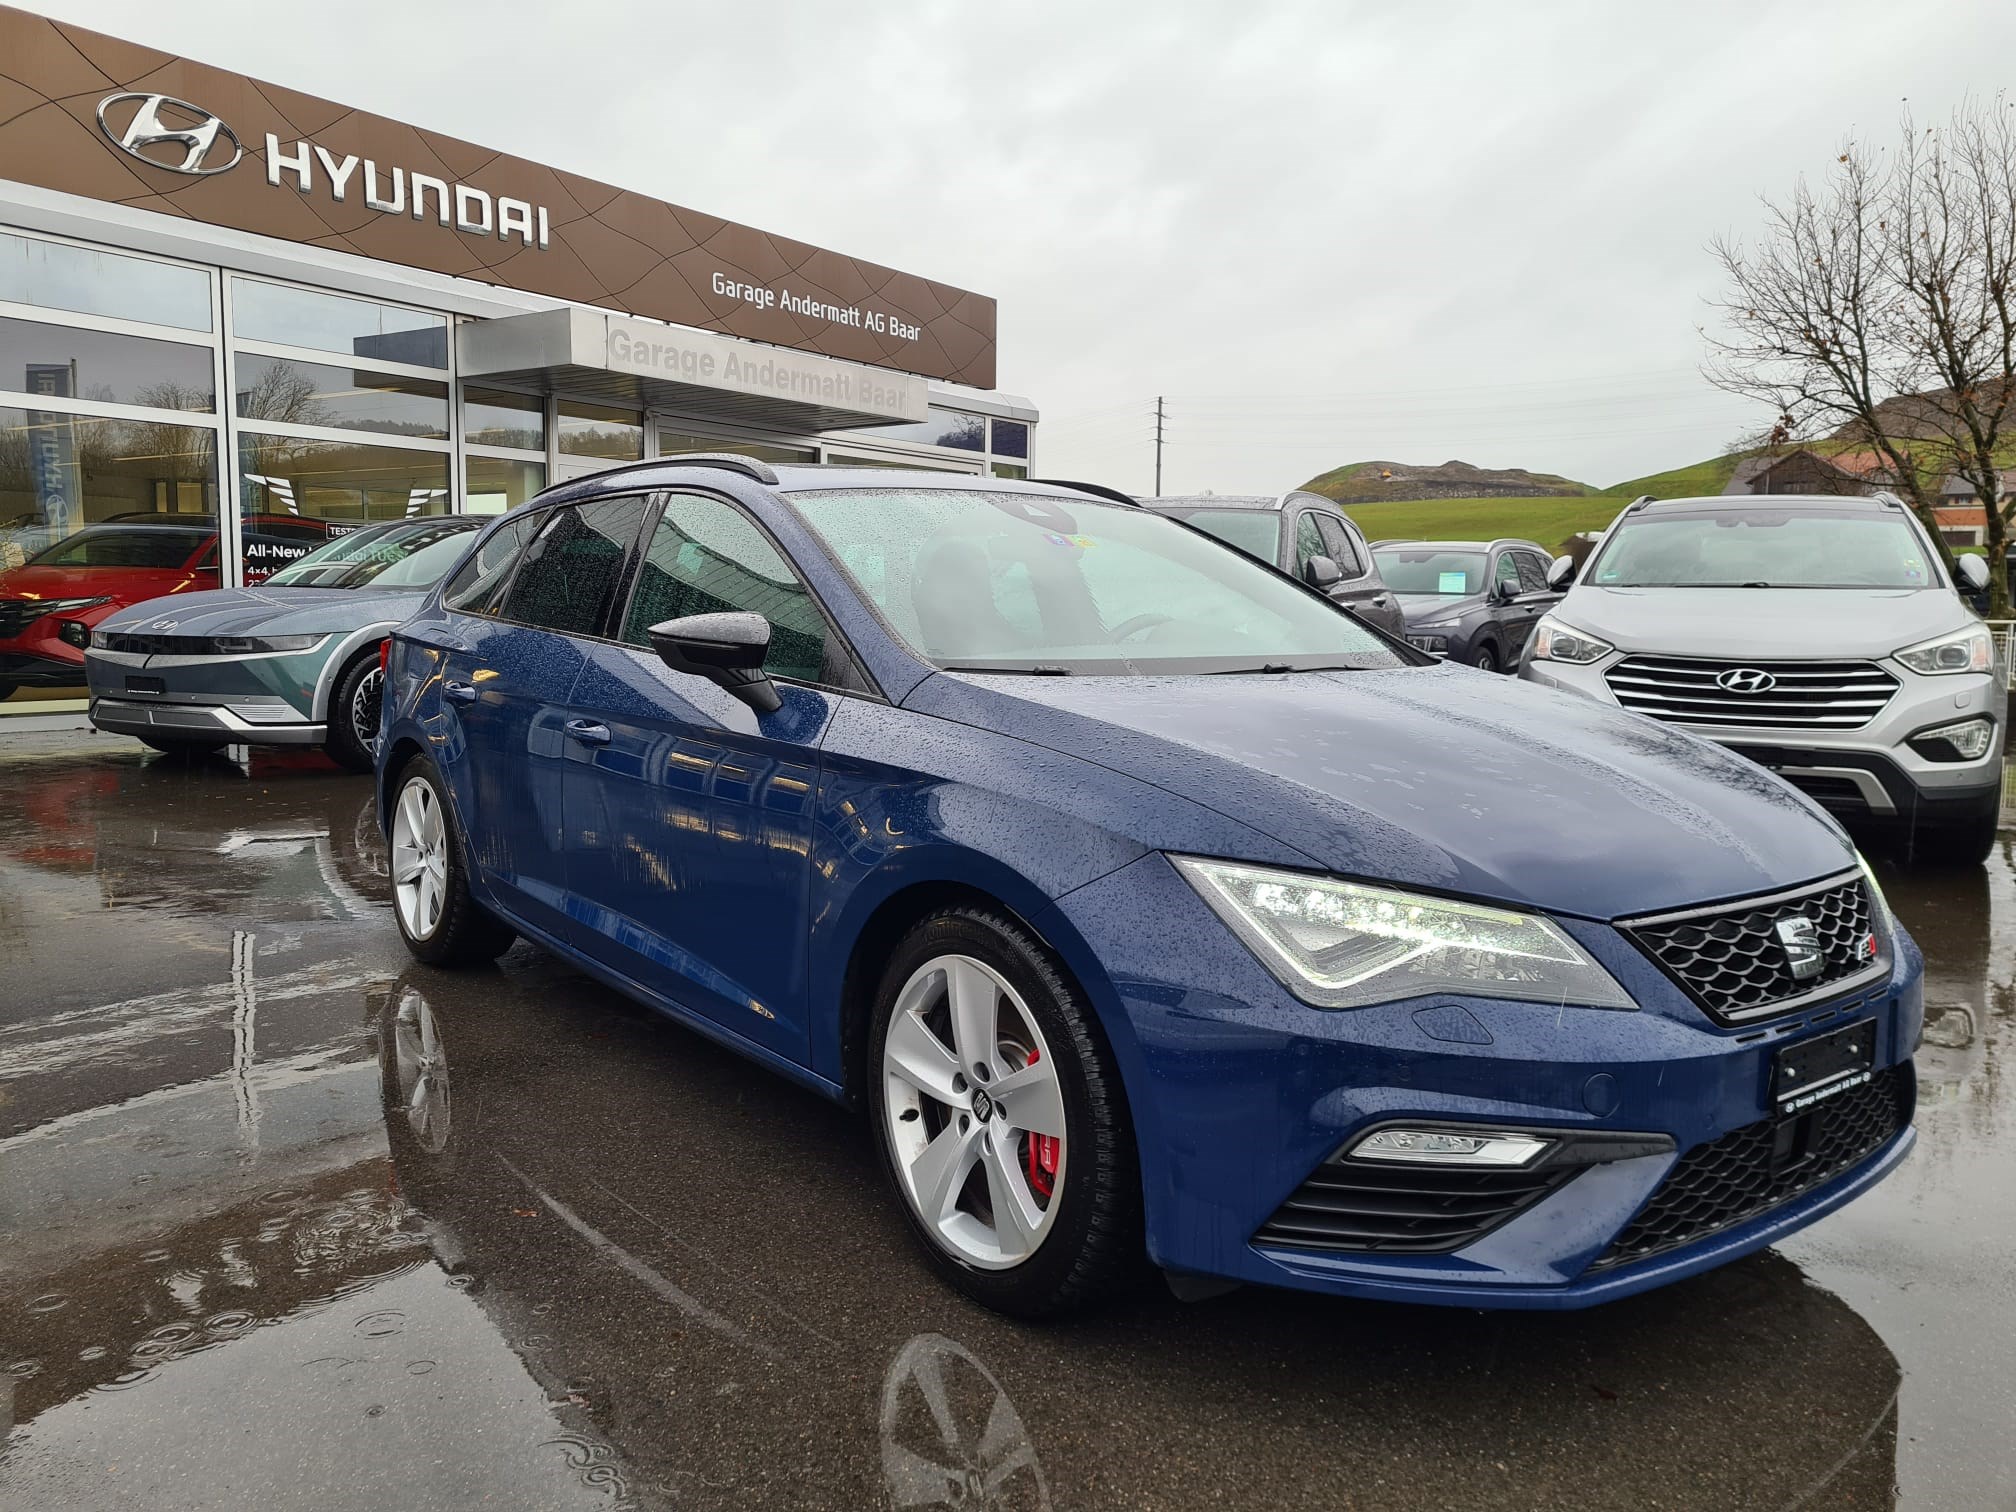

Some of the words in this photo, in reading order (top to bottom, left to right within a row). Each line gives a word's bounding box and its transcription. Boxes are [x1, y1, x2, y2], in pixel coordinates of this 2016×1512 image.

[265, 132, 549, 250] HYUNDAI
[712, 271, 774, 309] Garage
[780, 289, 860, 328] Andermatt
[865, 310, 885, 333] AG
[890, 316, 922, 341] Baar
[608, 328, 715, 380] Garage
[723, 351, 851, 401] Andermatt
[859, 375, 907, 409] Baar
[247, 544, 305, 558] All-New
